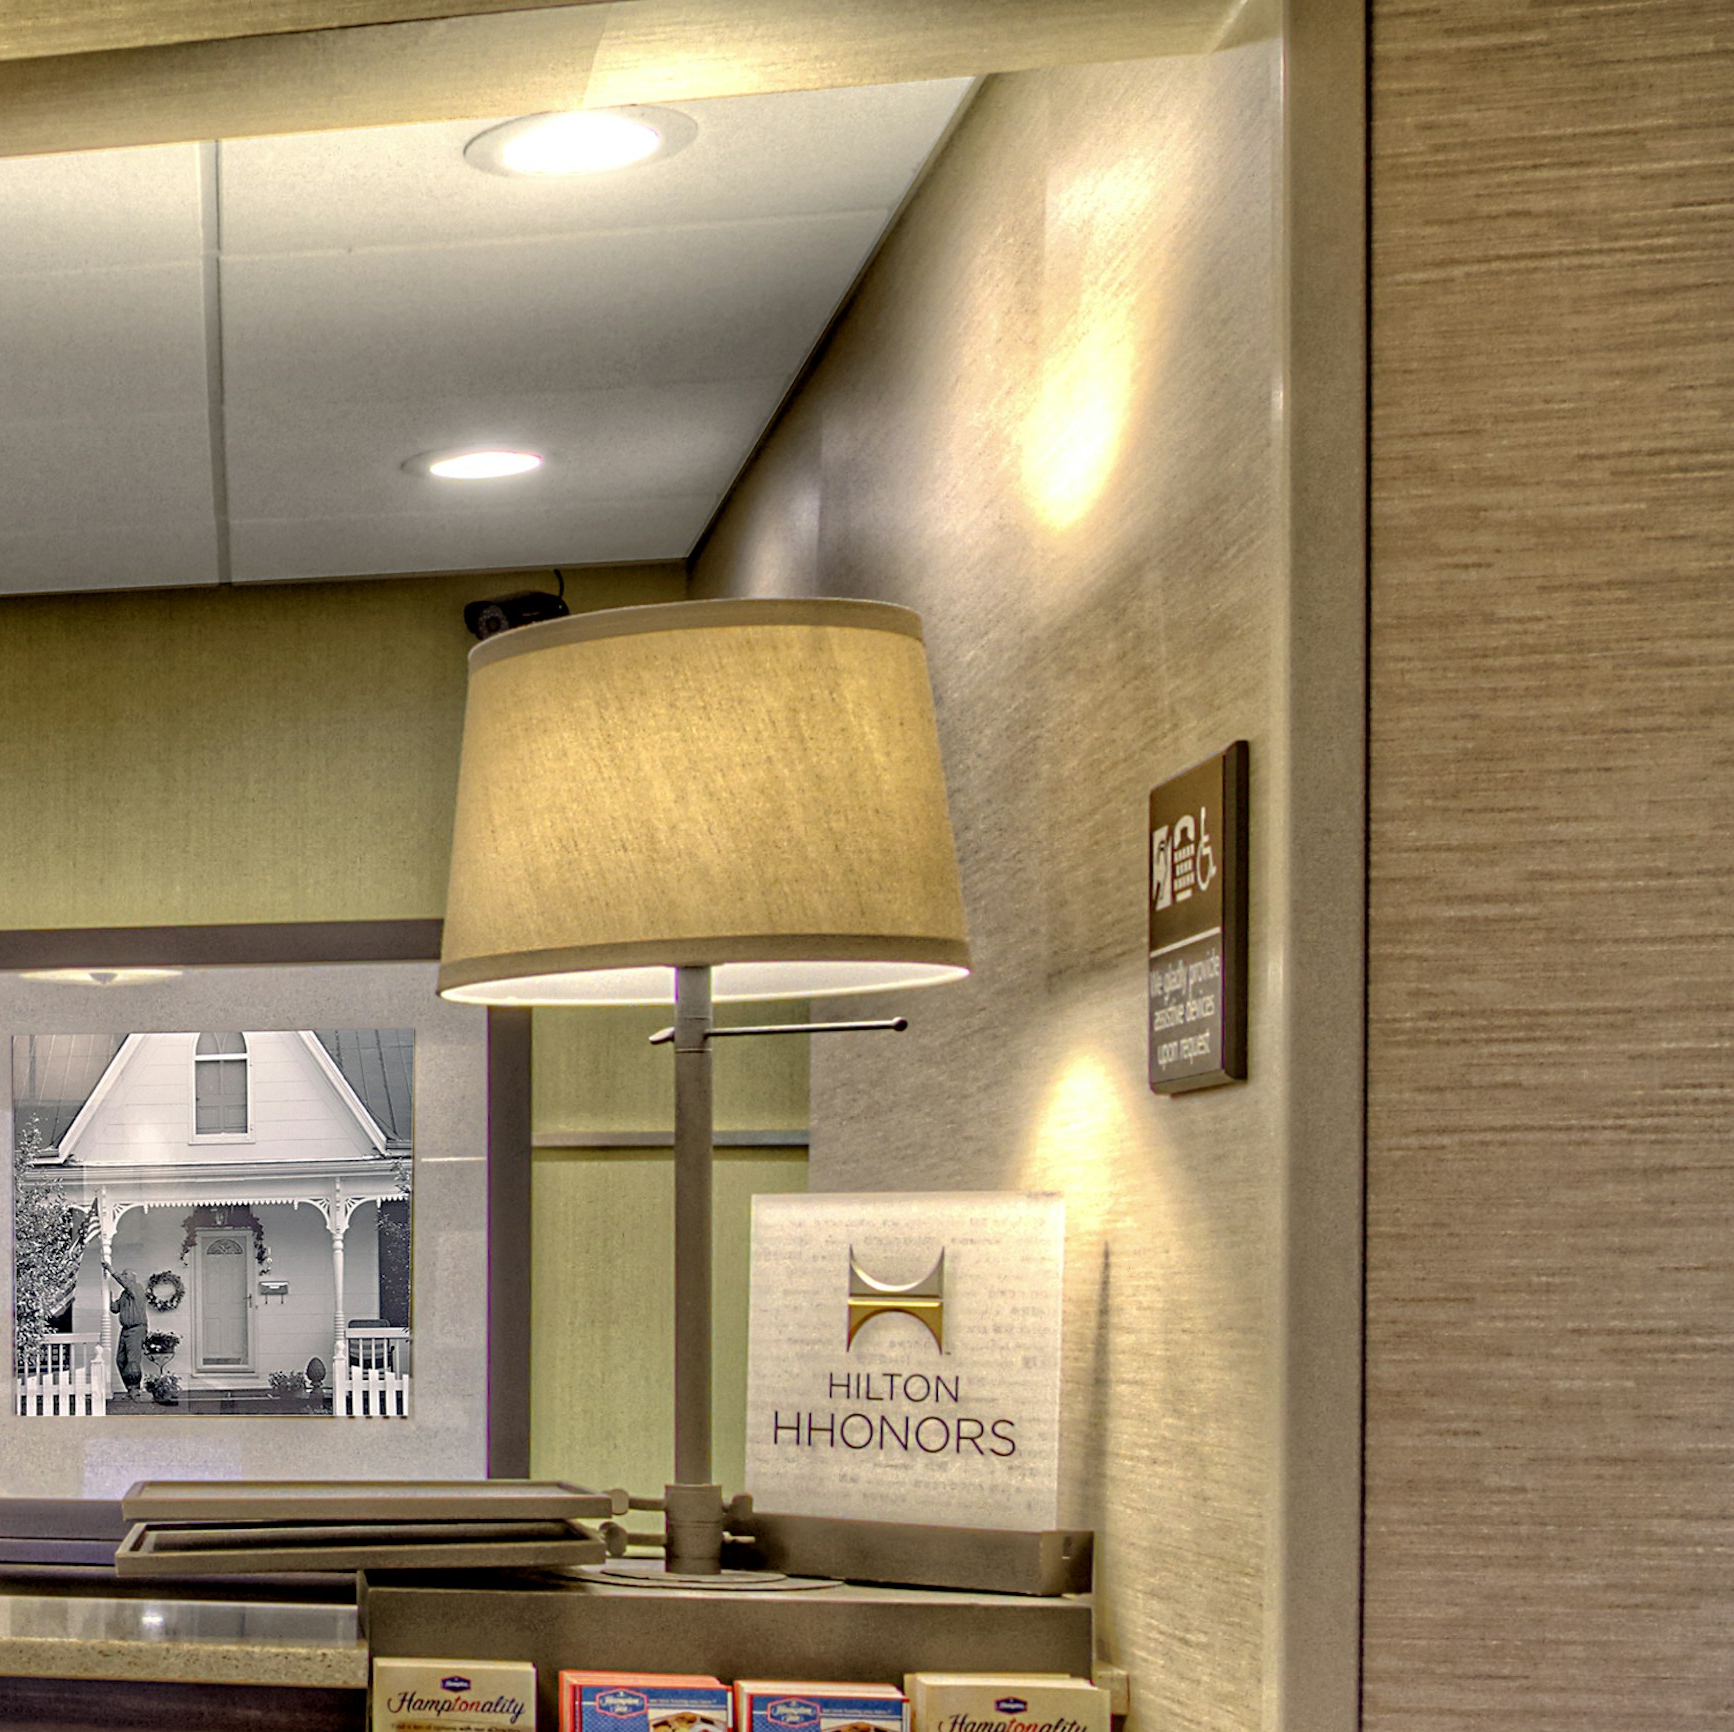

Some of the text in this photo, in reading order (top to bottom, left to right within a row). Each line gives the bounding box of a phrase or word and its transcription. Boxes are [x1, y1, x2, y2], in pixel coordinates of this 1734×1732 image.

[1164, 960, 1187, 1006] gladly
[1188, 948, 1220, 1001] provide
[1186, 990, 1215, 1022] devices
[1157, 1028, 1211, 1071] upon request
[829, 1372, 960, 1404] HILTON
[773, 1410, 1017, 1458] HHONORS
[387, 1690, 526, 1724] Hamptonality
